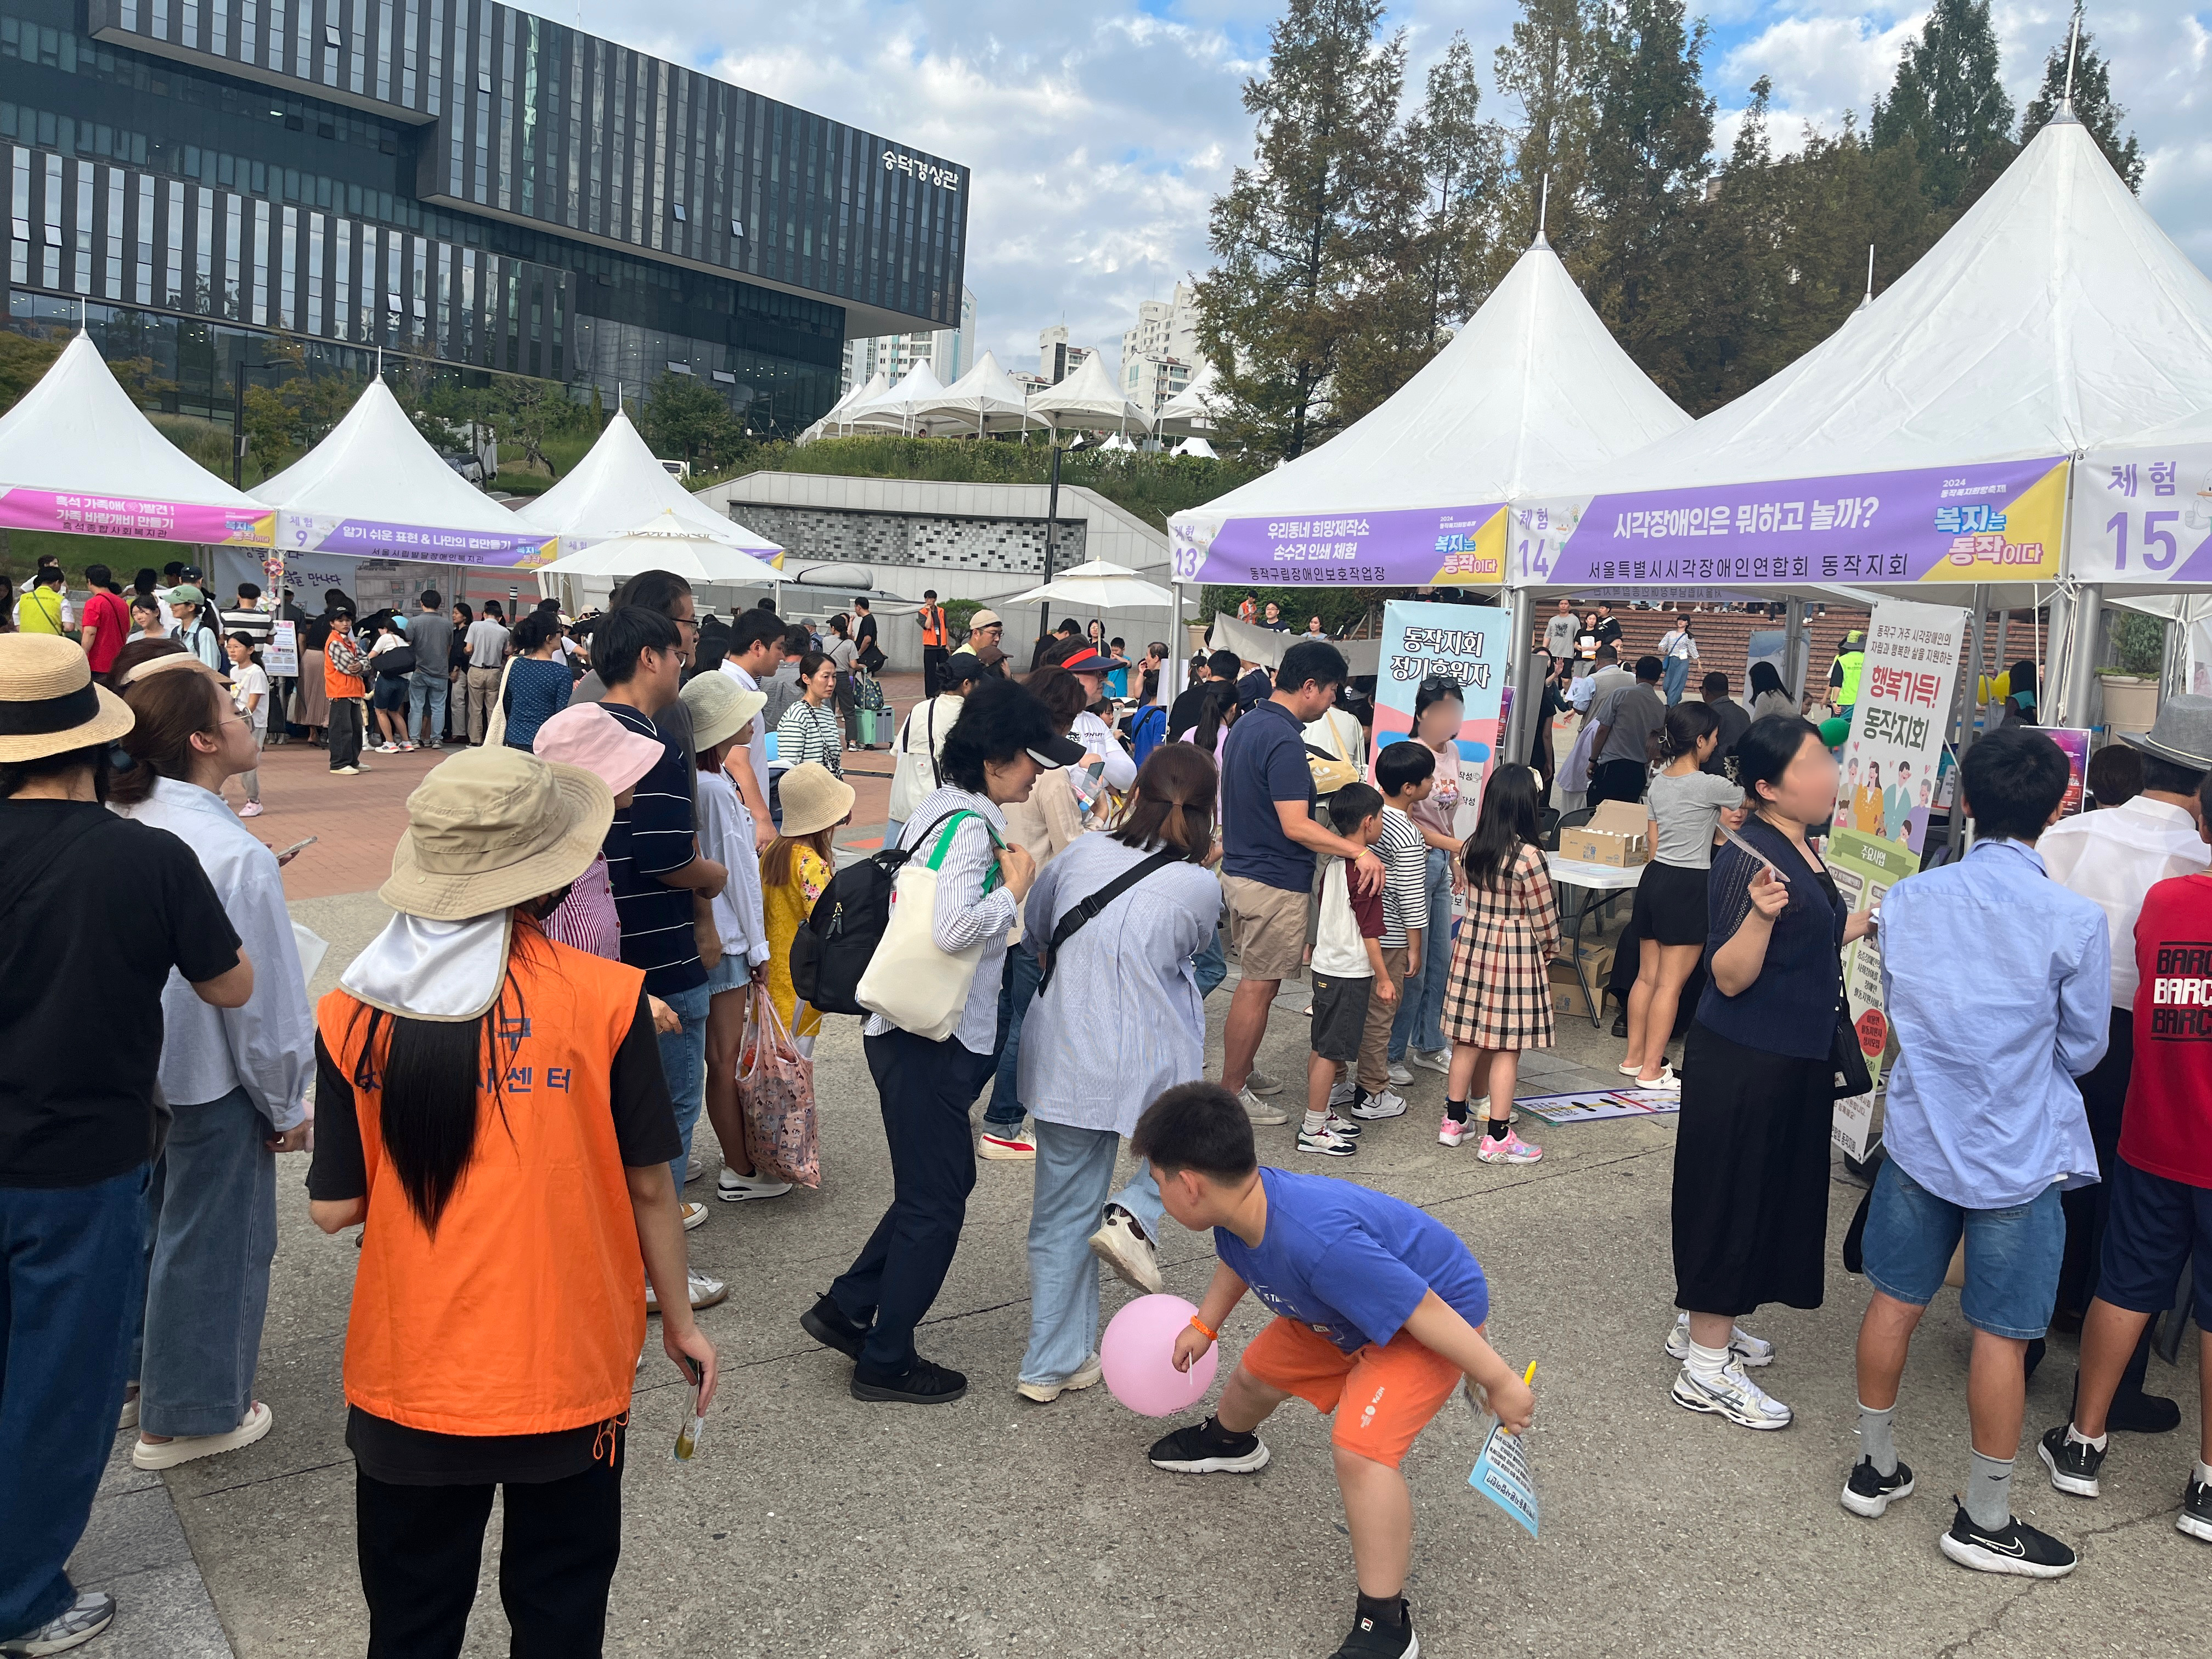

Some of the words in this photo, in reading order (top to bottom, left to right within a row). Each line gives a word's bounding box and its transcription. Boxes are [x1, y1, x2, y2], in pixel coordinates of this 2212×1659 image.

[882, 150, 958, 191] 숭덕경상관
[1943, 478, 1966, 487] 2024
[55, 495, 81, 507] 흑석
[57, 510, 81, 521] 가족
[85, 512, 134, 526] 바람개비
[138, 516, 173, 529] 만들기
[1267, 521, 1310, 539] 우리동네
[1312, 518, 1370, 538] 희망제작소
[1519, 507, 1548, 531] 체험
[1613, 506, 1730, 539] 시각장애인은
[1735, 501, 1804, 534] 뭐하고
[1809, 495, 1879, 531] 놀까?
[1934, 504, 2006, 534] 복지는
[63, 522, 167, 538] 흑석종합사회복지관
[296, 531, 308, 546] 9
[343, 526, 366, 539] 알기
[370, 529, 393, 541] 쉬운
[396, 531, 418, 544] 표현
[421, 534, 430, 545] &
[433, 534, 466, 548] 나만의
[469, 538, 510, 550] 컵만들기
[2106, 510, 2179, 571] 15
[1274, 544, 1306, 561] 손수건
[1308, 543, 1332, 560] 인쇄
[1333, 542, 1357, 560] 체험
[1435, 533, 1476, 553] 복지는
[1948, 534, 2044, 566] 동작이다
[372, 548, 483, 563] 서울시립발달장애인복지관
[1176, 548, 1197, 577] 13
[1443, 554, 1498, 574] 동작이다
[1518, 538, 1548, 577] 14
[1821, 553, 1908, 577] 동작지회
[1250, 567, 1385, 582] 동작구립장애인보호작업장
[1403, 627, 1484, 658] 동작지회
[1877, 625, 1896, 639] 동작구
[1898, 627, 1911, 641] 거주
[1912, 629, 1951, 646] 시각장애인의
[1871, 641, 1889, 655] 자립과
[1891, 644, 1910, 658] 행복한
[1911, 647, 1925, 661] 삶을
[1926, 649, 1953, 665] 지원하는
[1871, 665, 1941, 709] 행복가득!
[1864, 707, 1929, 752] 동작지회
[1861, 845, 1886, 867] 주요사업
[1372, 1386, 1385, 1403] NEPA
